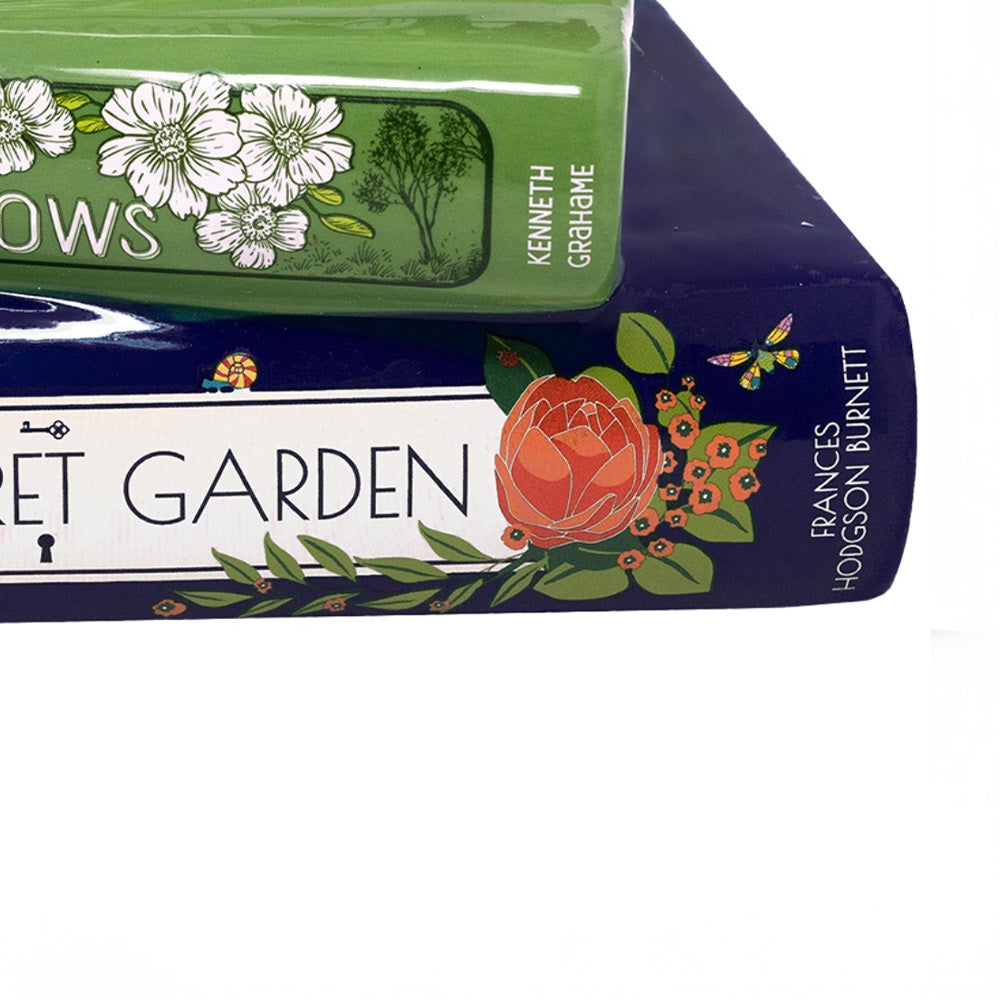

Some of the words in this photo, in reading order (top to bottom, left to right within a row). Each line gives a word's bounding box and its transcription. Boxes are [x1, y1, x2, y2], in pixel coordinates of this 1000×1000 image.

[527, 165, 554, 266] KENNETH
[841, 345, 871, 452] BURNETT
[122, 443, 471, 525] GARDEN
[811, 421, 840, 538] FRANCES
[832, 465, 870, 591] HODGSON
